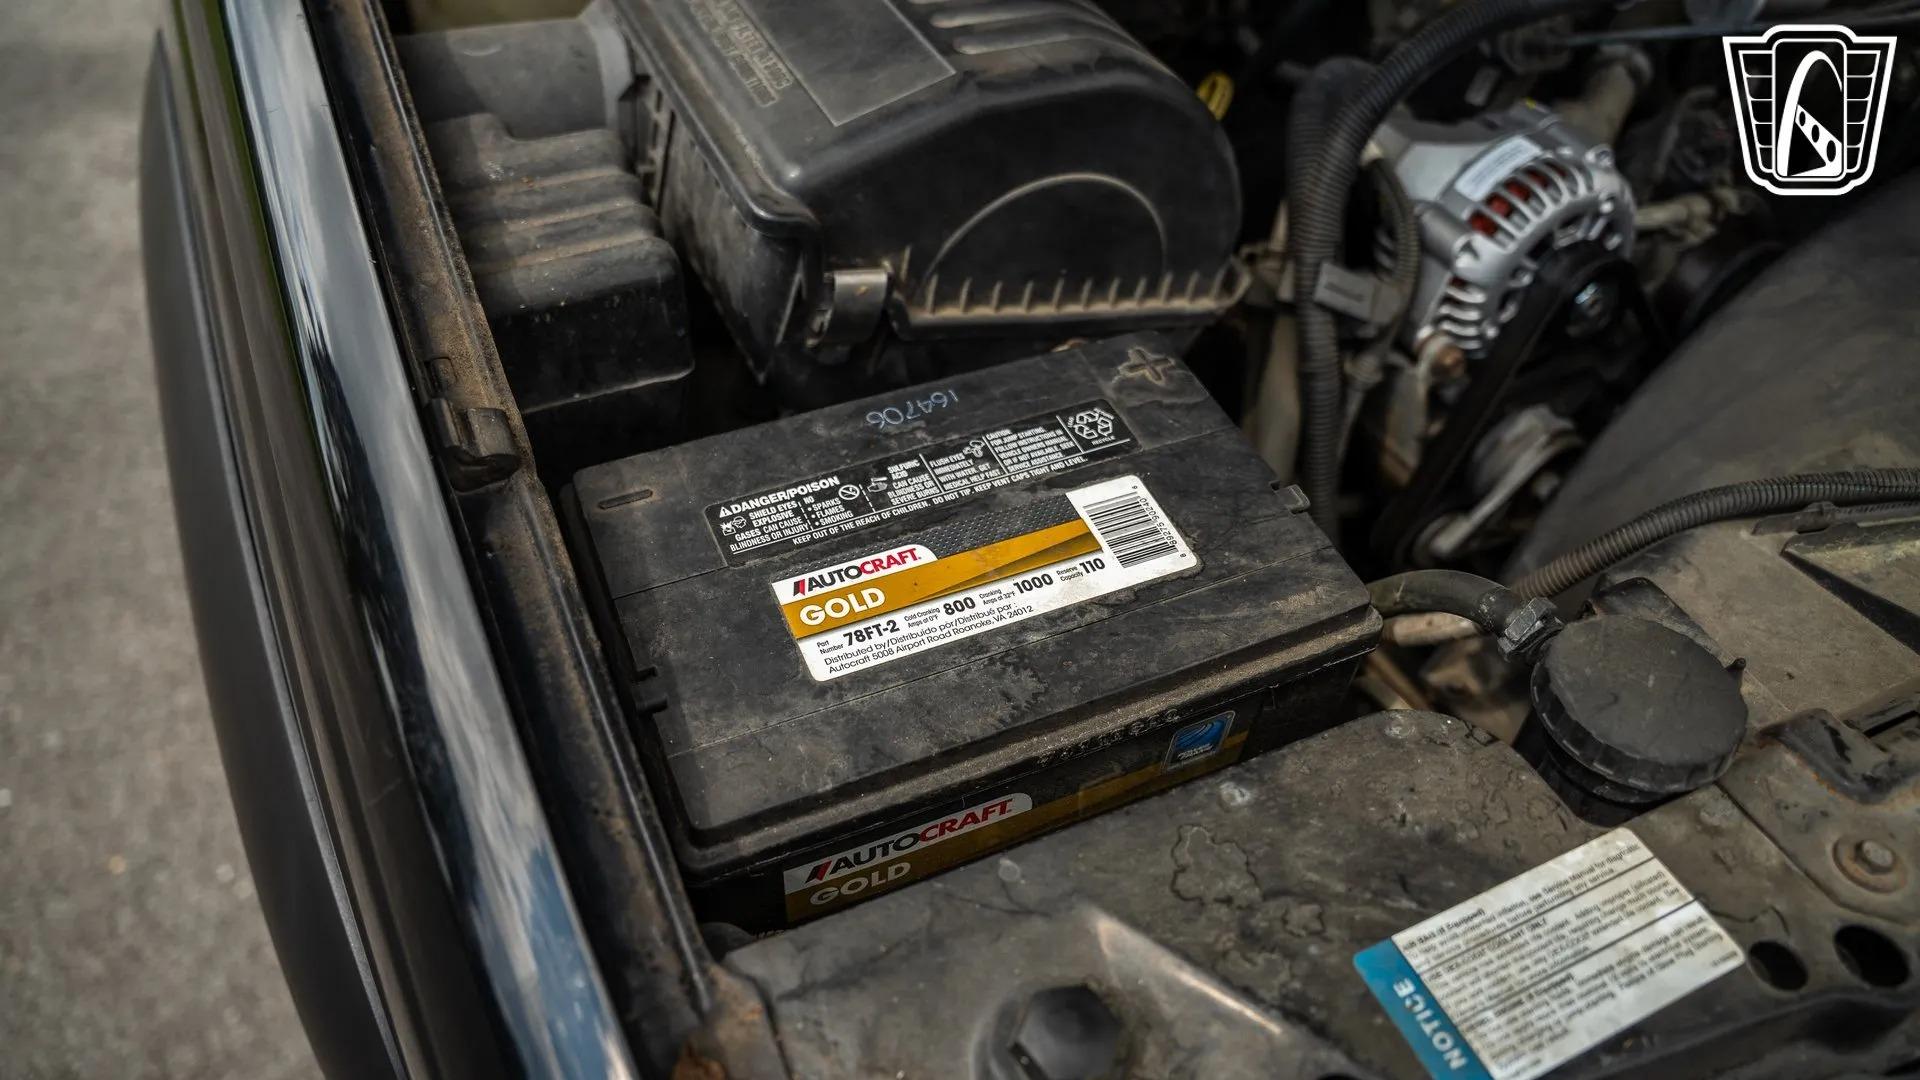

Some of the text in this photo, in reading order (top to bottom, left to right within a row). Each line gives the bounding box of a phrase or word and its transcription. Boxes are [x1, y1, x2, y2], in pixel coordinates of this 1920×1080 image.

[993, 441, 1018, 453] FOLLOW
[1018, 431, 1056, 447] INSTRUCTIONS
[1002, 433, 1018, 444] JUMP
[929, 452, 966, 468] FLUSH EYES
[998, 448, 1022, 460] VEHICLE
[1018, 452, 1030, 462] NOT
[1060, 440, 1076, 451] SEEK
[887, 460, 920, 474] SULFURIC
[890, 470, 908, 480] ACID
[933, 459, 974, 476] IMMEDIATELY
[938, 472, 955, 482] WITH
[978, 462, 991, 472] GET
[1007, 461, 1032, 473] SERVICE
[887, 480, 936, 498] BLINDNESS OR
[892, 473, 931, 490] CAN CAUSE
[943, 478, 971, 491] MEDICAL
[970, 473, 986, 484] HELP
[730, 475, 840, 515] DANGER/POISON
[792, 534, 812, 546] KEEP
[812, 529, 830, 540] OUT
[830, 526, 840, 536] OF
[840, 521, 857, 532] THE
[856, 514, 881, 529] REACH
[881, 511, 892, 520] OF
[892, 500, 931, 516] CHILDREN.
[932, 496, 944, 505] DO
[944, 492, 960, 502] NOT
[974, 483, 992, 495] KEEP
[992, 477, 1011, 488] VENT
[1010, 472, 1030, 484] CAPS
[1030, 465, 1050, 478] TIGHT
[1050, 462, 1066, 472] AND
[804, 495, 815, 504] NO
[890, 487, 941, 506] SEVERE BURNS
[749, 501, 798, 520] SHIELD EYES
[812, 497, 842, 512] SPARKS
[816, 505, 845, 519] FLAMES
[752, 510, 795, 528] EXPLOSIVE
[820, 511, 854, 526] SMOKING
[730, 524, 809, 552] BLINDNESS OR INJURY
[735, 517, 803, 542] GASES CAN CAUSE
[807, 548, 919, 593] AUTOCRAFT
[1056, 566, 1078, 576] Reserve
[1079, 558, 1106, 574] 110
[1013, 573, 1054, 594] 1000
[1060, 572, 1084, 582] Capacity
[979, 588, 1002, 600] Cranking
[982, 596, 998, 606] Amps
[997, 594, 1004, 602] at
[800, 587, 886, 626] GOLD
[904, 606, 940, 622] Cold Cranking
[943, 596, 976, 616] 800
[842, 619, 901, 647] 78FT-2
[908, 620, 923, 629] Amps
[824, 645, 874, 666] Distributed
[874, 626, 938, 651] by/Distribuido
[938, 608, 996, 631] por/Distribué
[996, 602, 1012, 615] par
[829, 654, 872, 674] Autocraft
[872, 648, 895, 661] 5008
[896, 638, 927, 655] Airport
[928, 630, 951, 644] Road
[1007, 605, 1034, 620] 24012
[816, 640, 830, 648] Part
[820, 643, 844, 655] Number
[830, 797, 1013, 876] AUTOCRAFT
[809, 862, 911, 906] GOLD
[1392, 976, 1469, 1070] NOTICE
